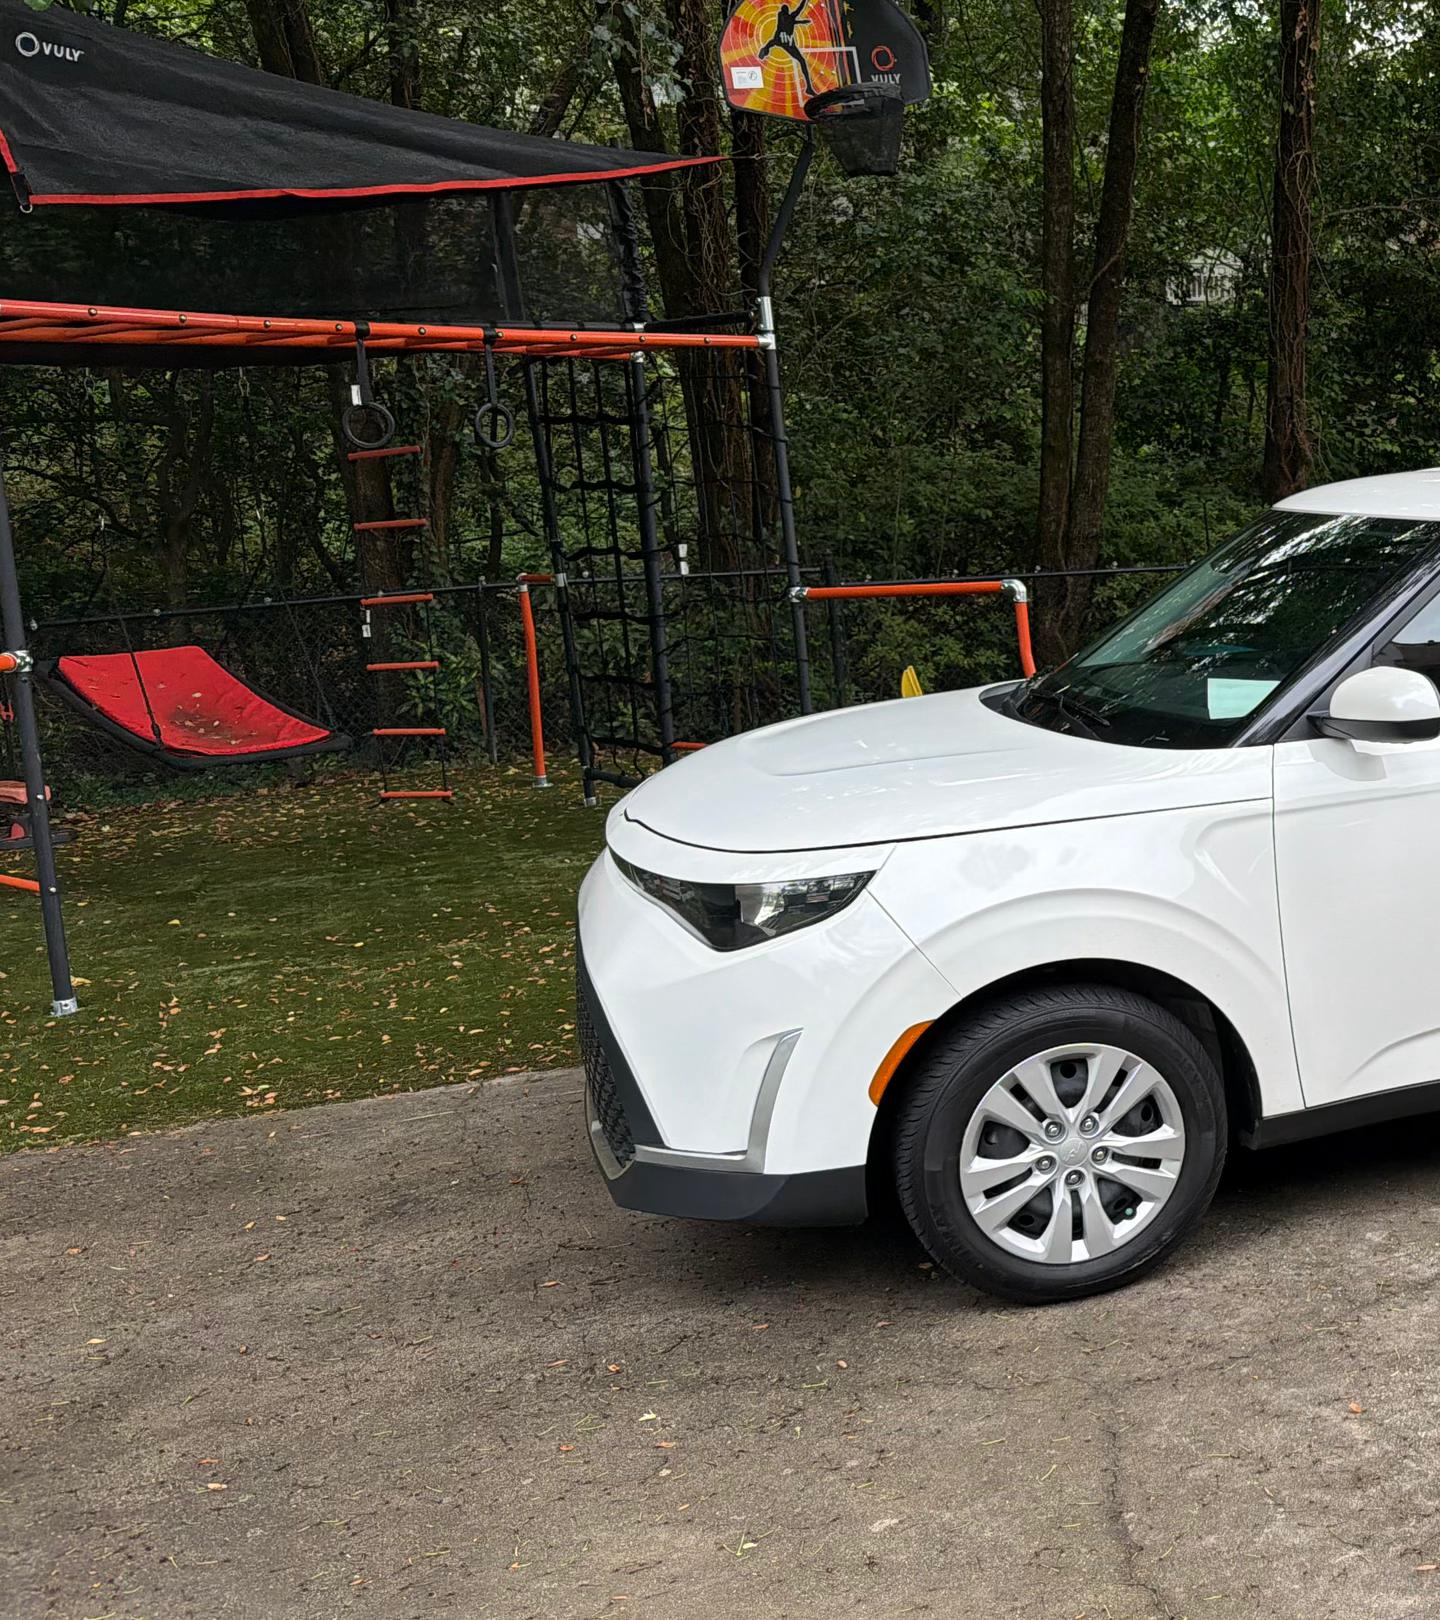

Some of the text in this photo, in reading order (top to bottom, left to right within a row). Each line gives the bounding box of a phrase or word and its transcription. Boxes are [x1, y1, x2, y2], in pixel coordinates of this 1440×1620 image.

[779, 31, 794, 47] fly
[42, 42, 82, 62] VULY
[871, 73, 901, 84] VULY
